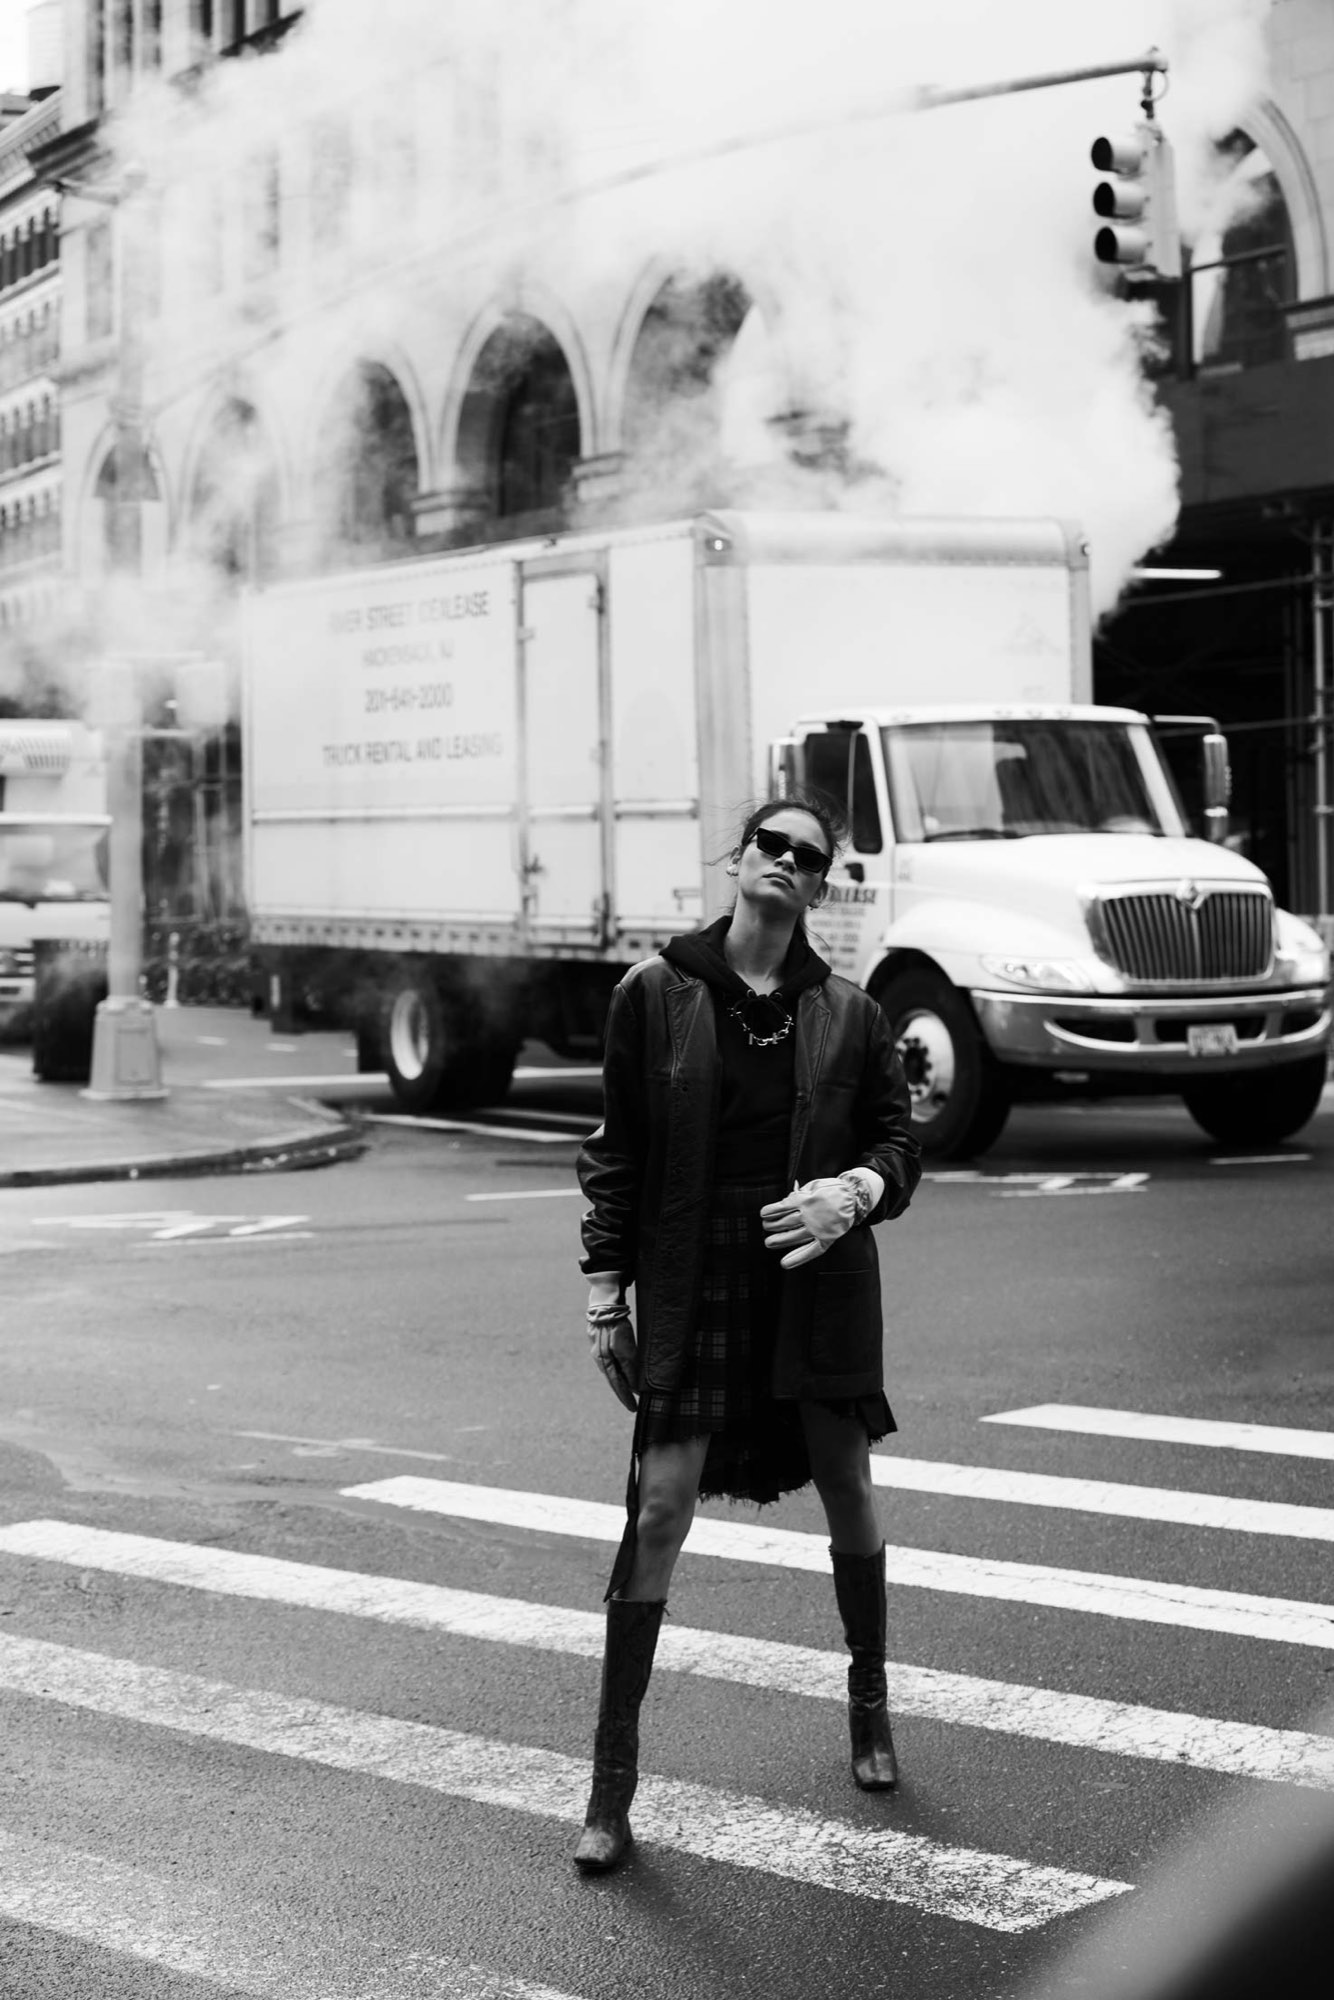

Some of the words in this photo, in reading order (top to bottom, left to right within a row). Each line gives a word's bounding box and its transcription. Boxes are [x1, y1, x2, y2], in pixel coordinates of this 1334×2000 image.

[366, 603, 413, 631] STREET
[321, 742, 360, 768] TRUCK
[364, 740, 412, 766] RENTAL
[416, 737, 443, 761] AND
[447, 731, 503, 760] LEASING
